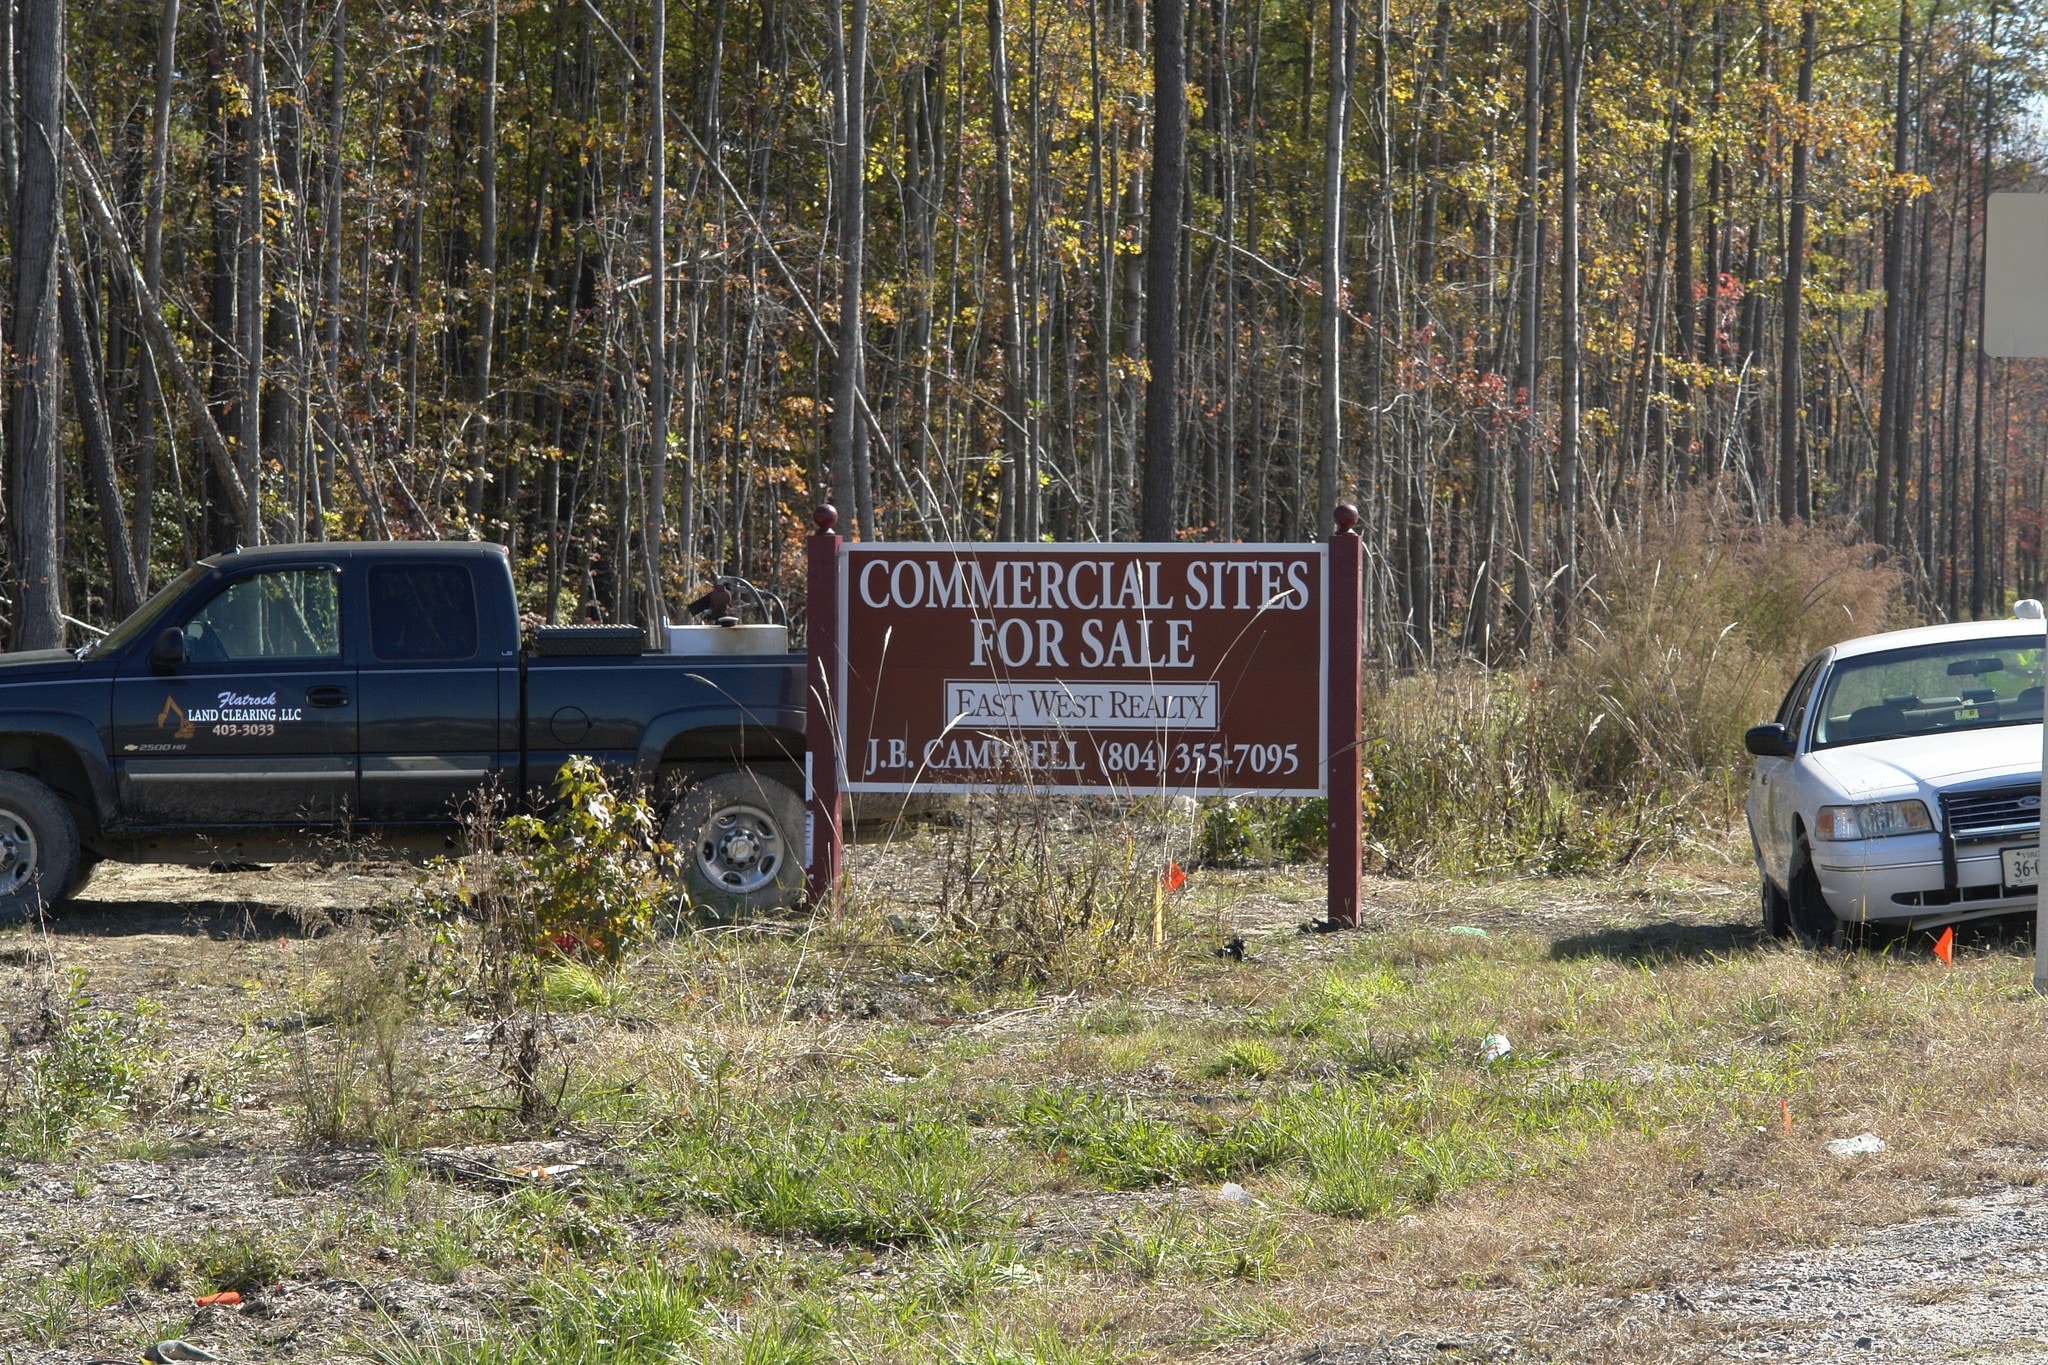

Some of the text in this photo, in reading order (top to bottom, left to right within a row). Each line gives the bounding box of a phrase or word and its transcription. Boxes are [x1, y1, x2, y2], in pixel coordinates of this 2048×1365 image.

[860, 559, 1309, 610] COMMERCIAL SITES
[970, 618, 1195, 668] FOR SALE
[188, 709, 219, 721] LAND
[221, 708, 276, 721] CLEARING
[217, 691, 277, 708] Flatrock
[956, 689, 1208, 719] EAST WEST REALTY
[212, 724, 275, 736] 403-3033
[865, 738, 914, 776] J.B.
[1099, 740, 1164, 778] (804)
[1175, 742, 1299, 776] 355-7095
